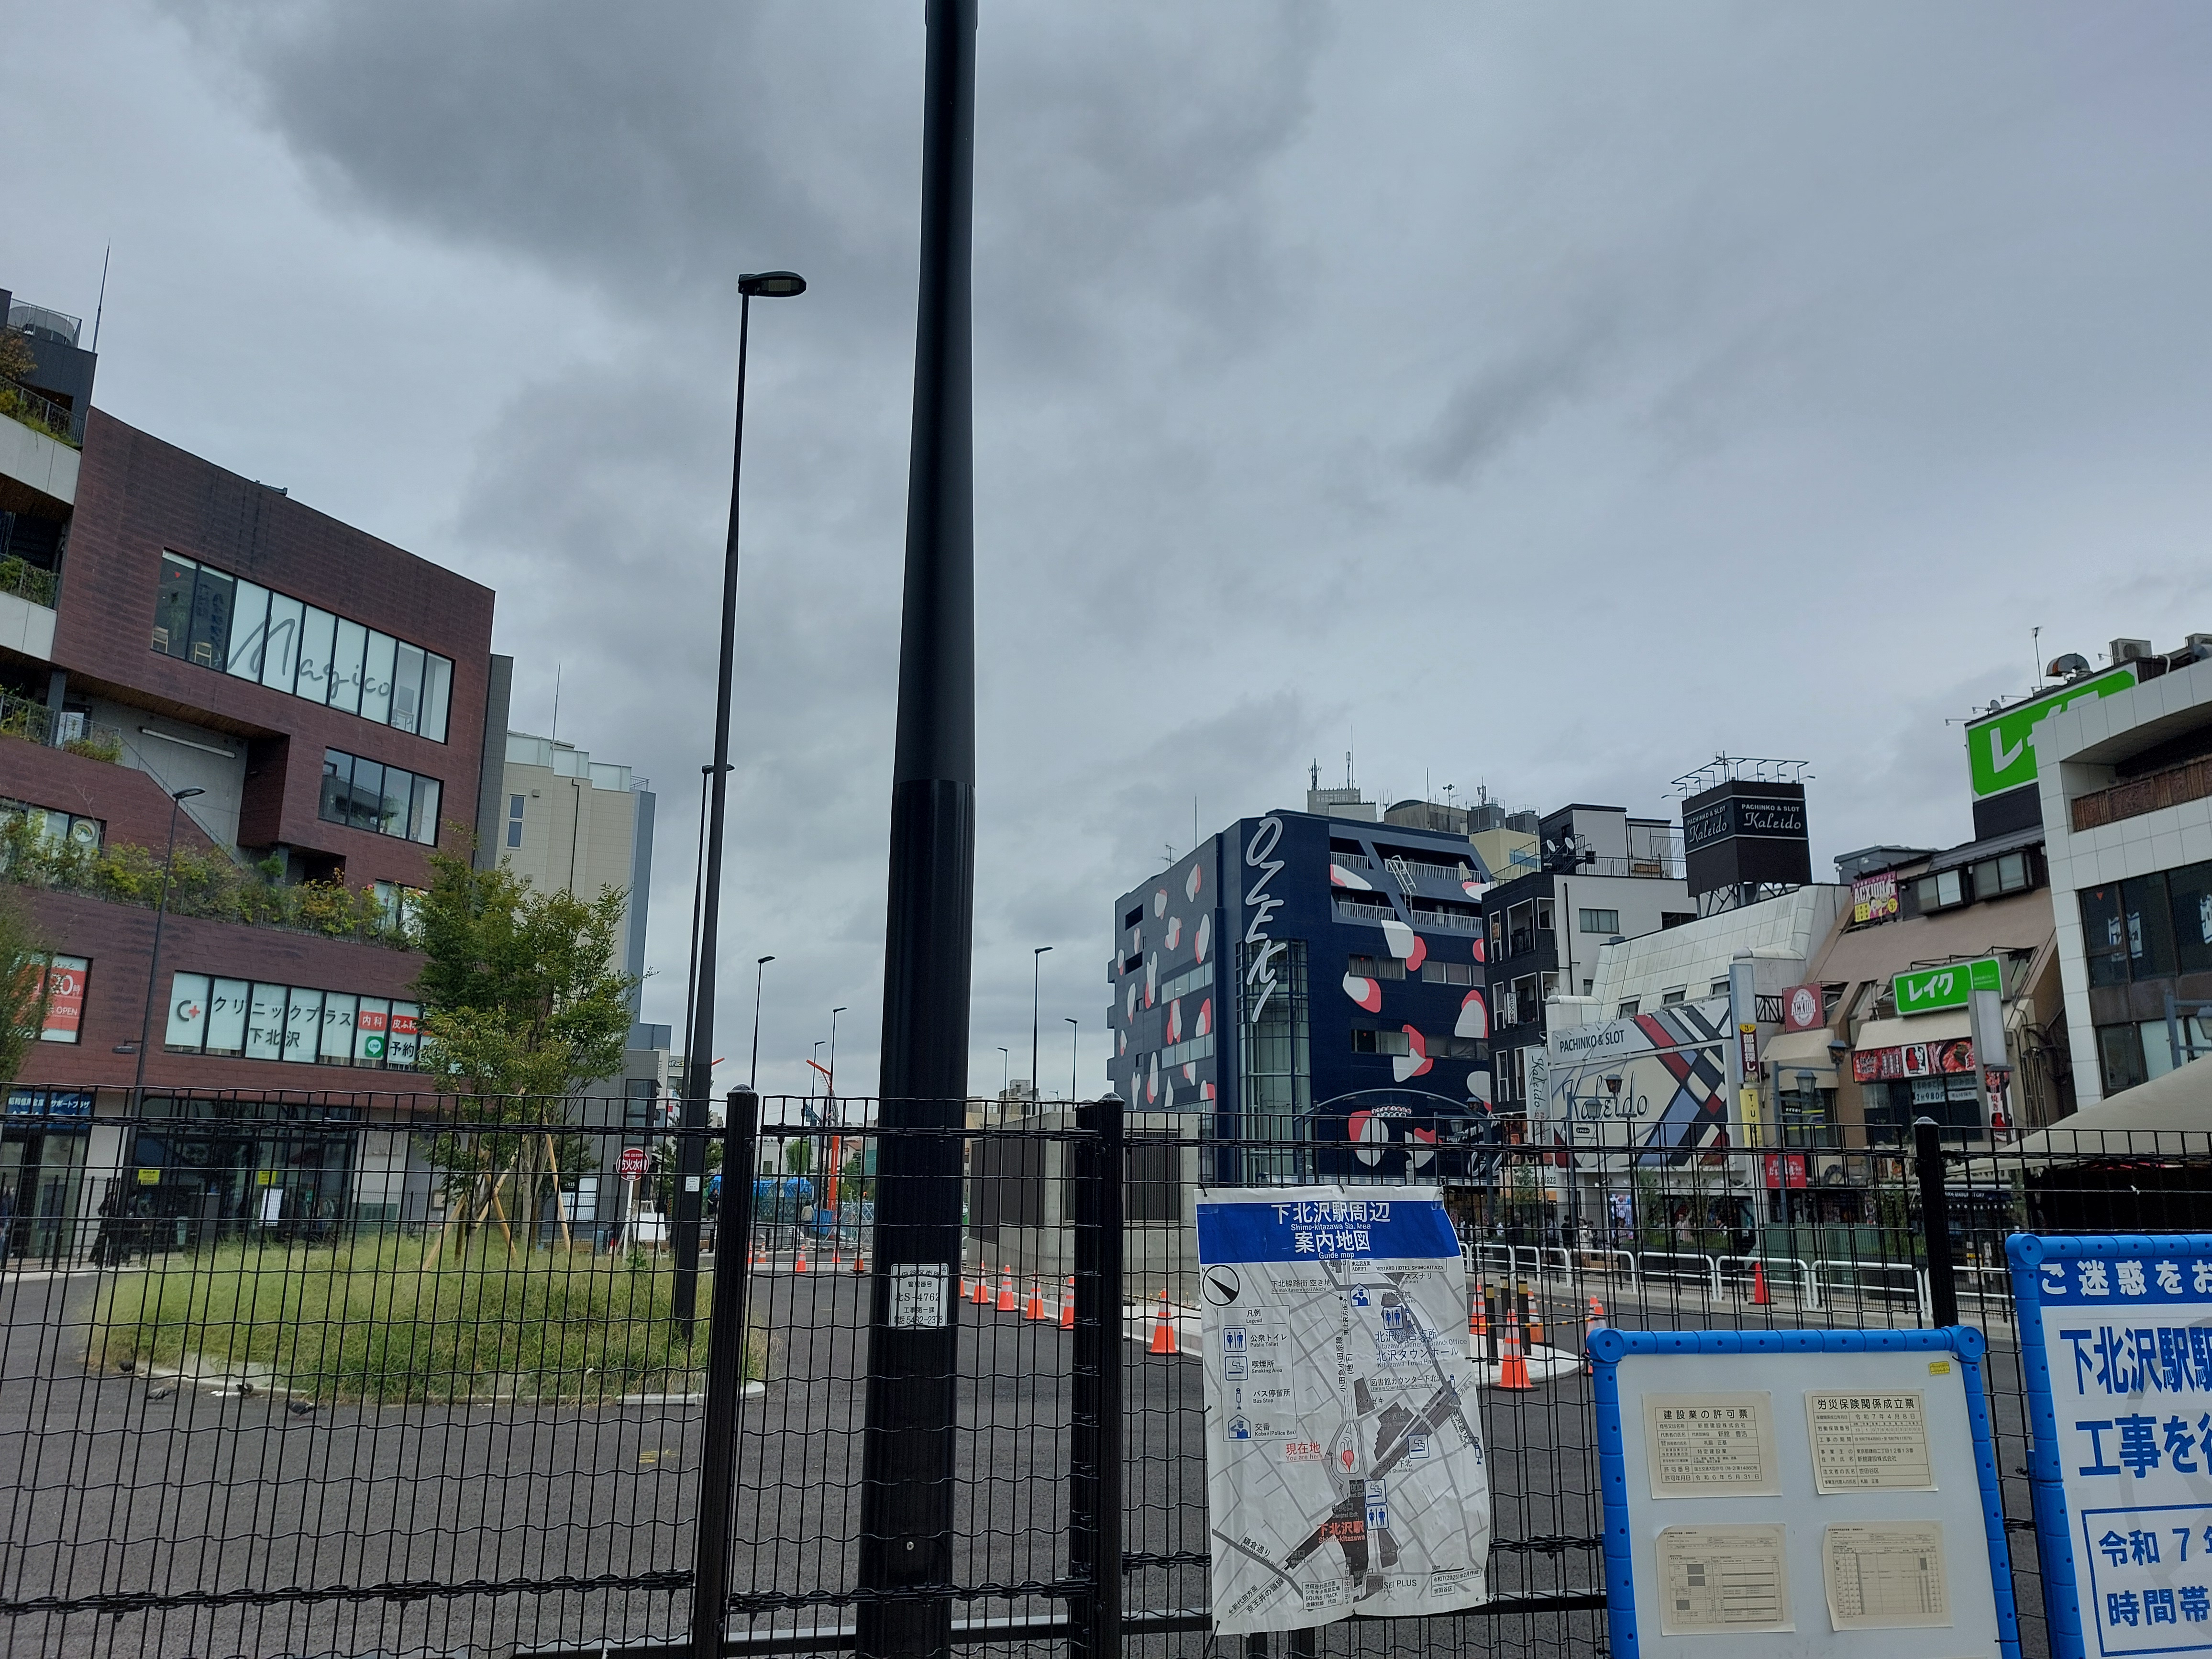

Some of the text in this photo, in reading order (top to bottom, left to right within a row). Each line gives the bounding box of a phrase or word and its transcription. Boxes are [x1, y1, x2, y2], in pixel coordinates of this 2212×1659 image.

[228, 616, 391, 699] Magico
[1687, 812, 1709, 826] PACHINKO
[1714, 805, 1726, 816] SLOT
[1744, 812, 1801, 830] Kaleido
[1689, 815, 1727, 843] Kaleido
[1245, 817, 1287, 1023] OZEKI
[1908, 972, 1954, 1002] レイク
[56, 1006, 77, 1016] OPEN
[214, 996, 351, 1026] クリニックプラス
[1791, 999, 1816, 1016] ACXION
[362, 1015, 382, 1027] 内科
[392, 1019, 416, 1031] 皮ふ科
[250, 1028, 300, 1048] 下北沢
[1559, 1030, 1625, 1053] PACHINKO & SLOT
[390, 1041, 415, 1057] 予約
[1529, 1055, 1548, 1108] Kaleido
[1271, 1202, 1391, 1225] 下北沢駅周辺
[1291, 1221, 1371, 1231] Shimo-kitazawa Sta. Area
[1294, 1229, 1371, 1254] 案内地図
[1318, 1251, 1355, 1260] Guide map
[1271, 1278, 1331, 1288] 下北線路街 空き地
[2039, 1259, 2212, 1297] ご迷惑をお
[1247, 1309, 1261, 1317] 凡例
[1250, 1333, 1287, 1342] 公衆トイレ
[1376, 1347, 1459, 1361] 北沢タウンホール
[1251, 1360, 1274, 1369] 喫煙所
[1370, 1374, 1443, 1386] 図書館カウンター下北沢
[1253, 1388, 1291, 1397] バス停留所
[1818, 1398, 1915, 1410] 労災保険関係成立票
[1663, 1409, 1748, 1420] 建設業の許可票
[1255, 1422, 1271, 1431] 交番
[1286, 1441, 1321, 1455] 現在地
[1317, 1520, 1364, 1536] 下北沢駅
[1231, 1584, 1258, 1612] 新代田方面
[1246, 1577, 1285, 1615] 京王井の頭線
[1434, 1586, 1453, 1594] 世田谷区
[2107, 1585, 2211, 1627] 時間帯
